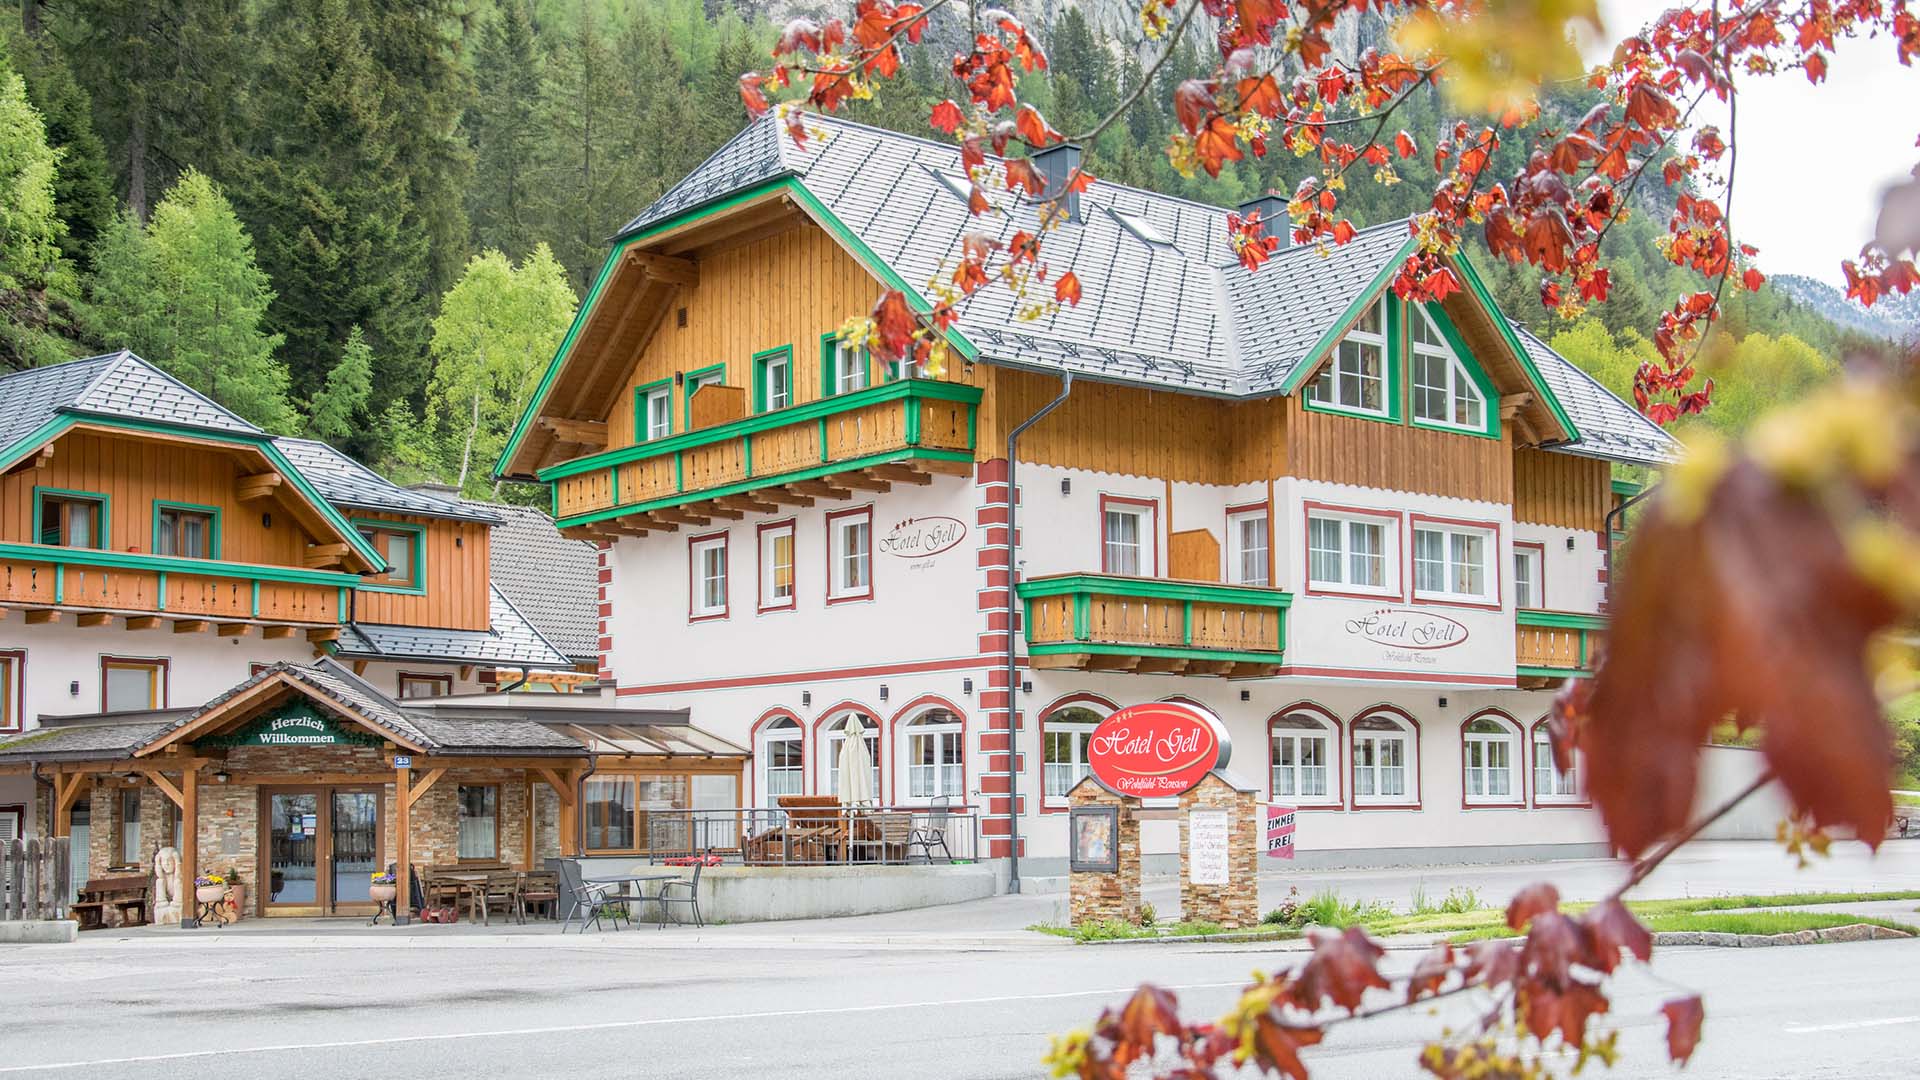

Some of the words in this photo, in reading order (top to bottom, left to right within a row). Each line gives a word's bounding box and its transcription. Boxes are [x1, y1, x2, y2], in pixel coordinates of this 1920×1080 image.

[879, 529, 921, 552] Hotel
[925, 523, 957, 551] Gell
[1345, 616, 1407, 637] Hotel
[1412, 622, 1455, 644] Gell
[271, 716, 325, 731] Herzlich
[259, 733, 335, 743] Willkommen
[1093, 728, 1153, 755] Hotel
[1155, 728, 1200, 762] Gell
[397, 757, 409, 765] 23
[1267, 813, 1295, 830] ZIMMER
[1269, 834, 1291, 850] FREI
